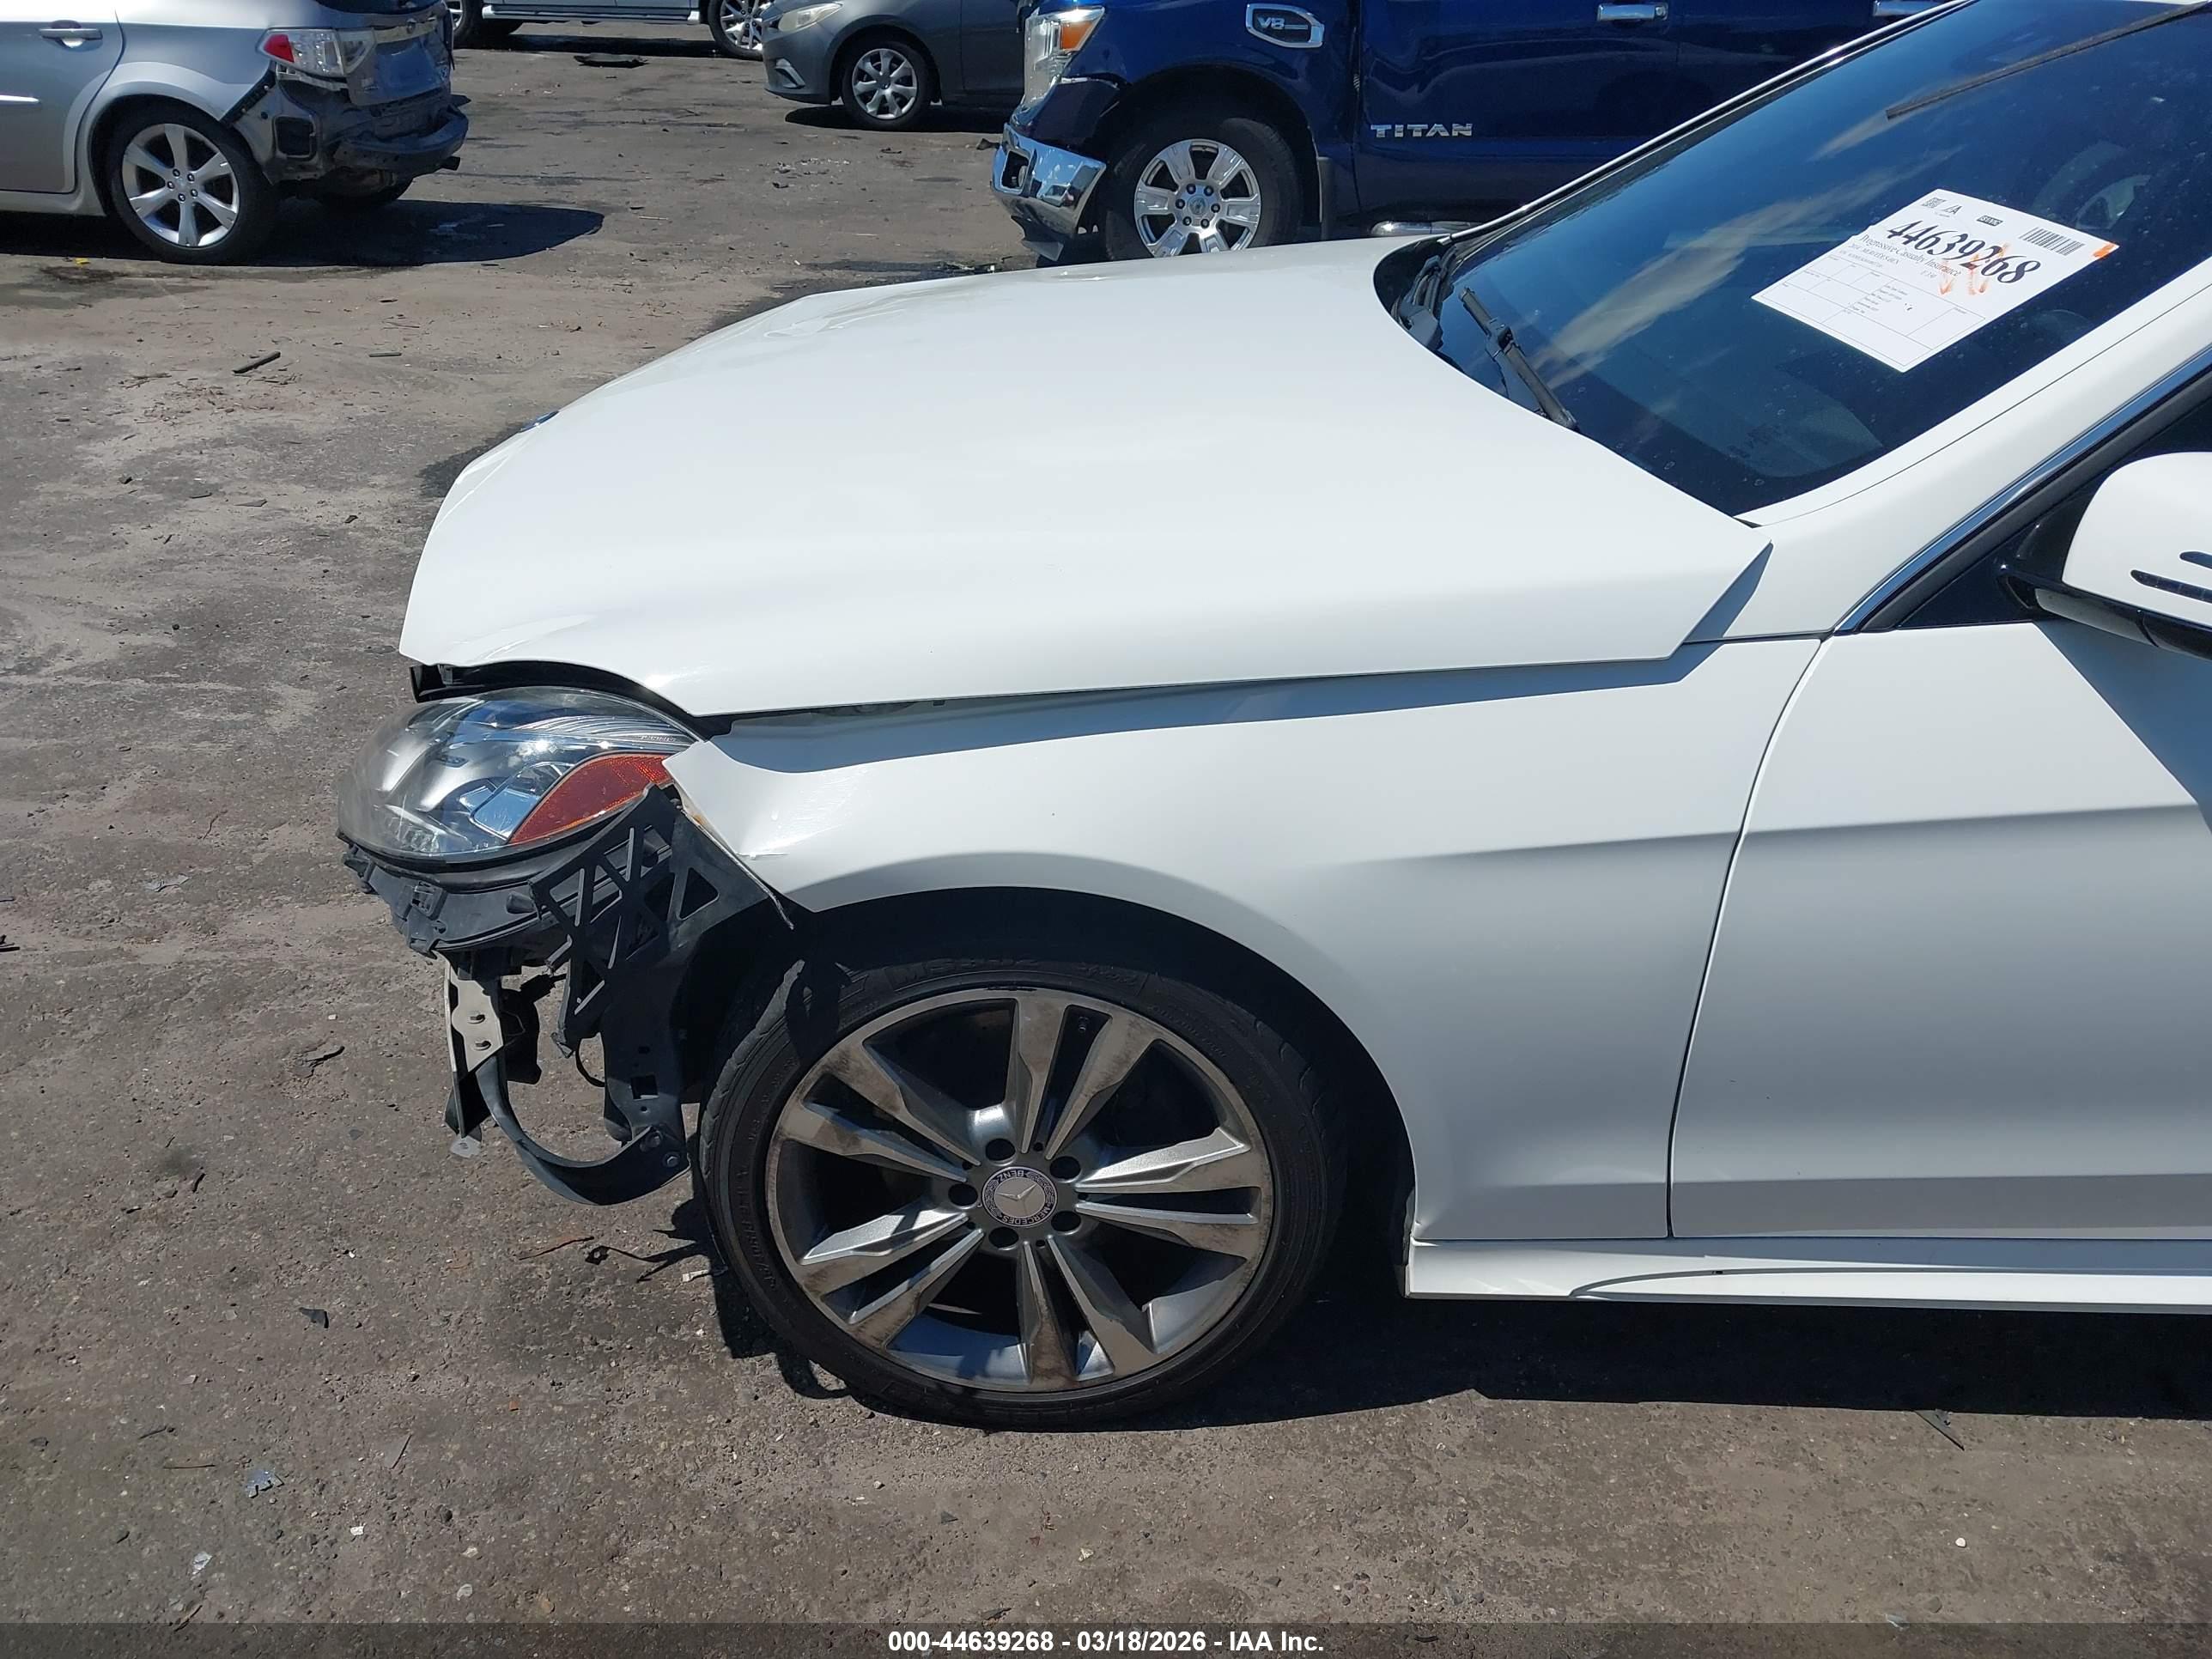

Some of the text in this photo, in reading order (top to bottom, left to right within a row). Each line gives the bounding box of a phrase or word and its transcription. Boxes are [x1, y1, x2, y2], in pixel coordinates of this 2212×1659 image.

[1256, 15, 1285, 30] V8
[1370, 123, 1474, 138] TITAN
[1887, 220, 2041, 284] 44639268
[996, 1170, 1024, 1182] BENZ
[1002, 1206, 1051, 1224] MERCEDES
